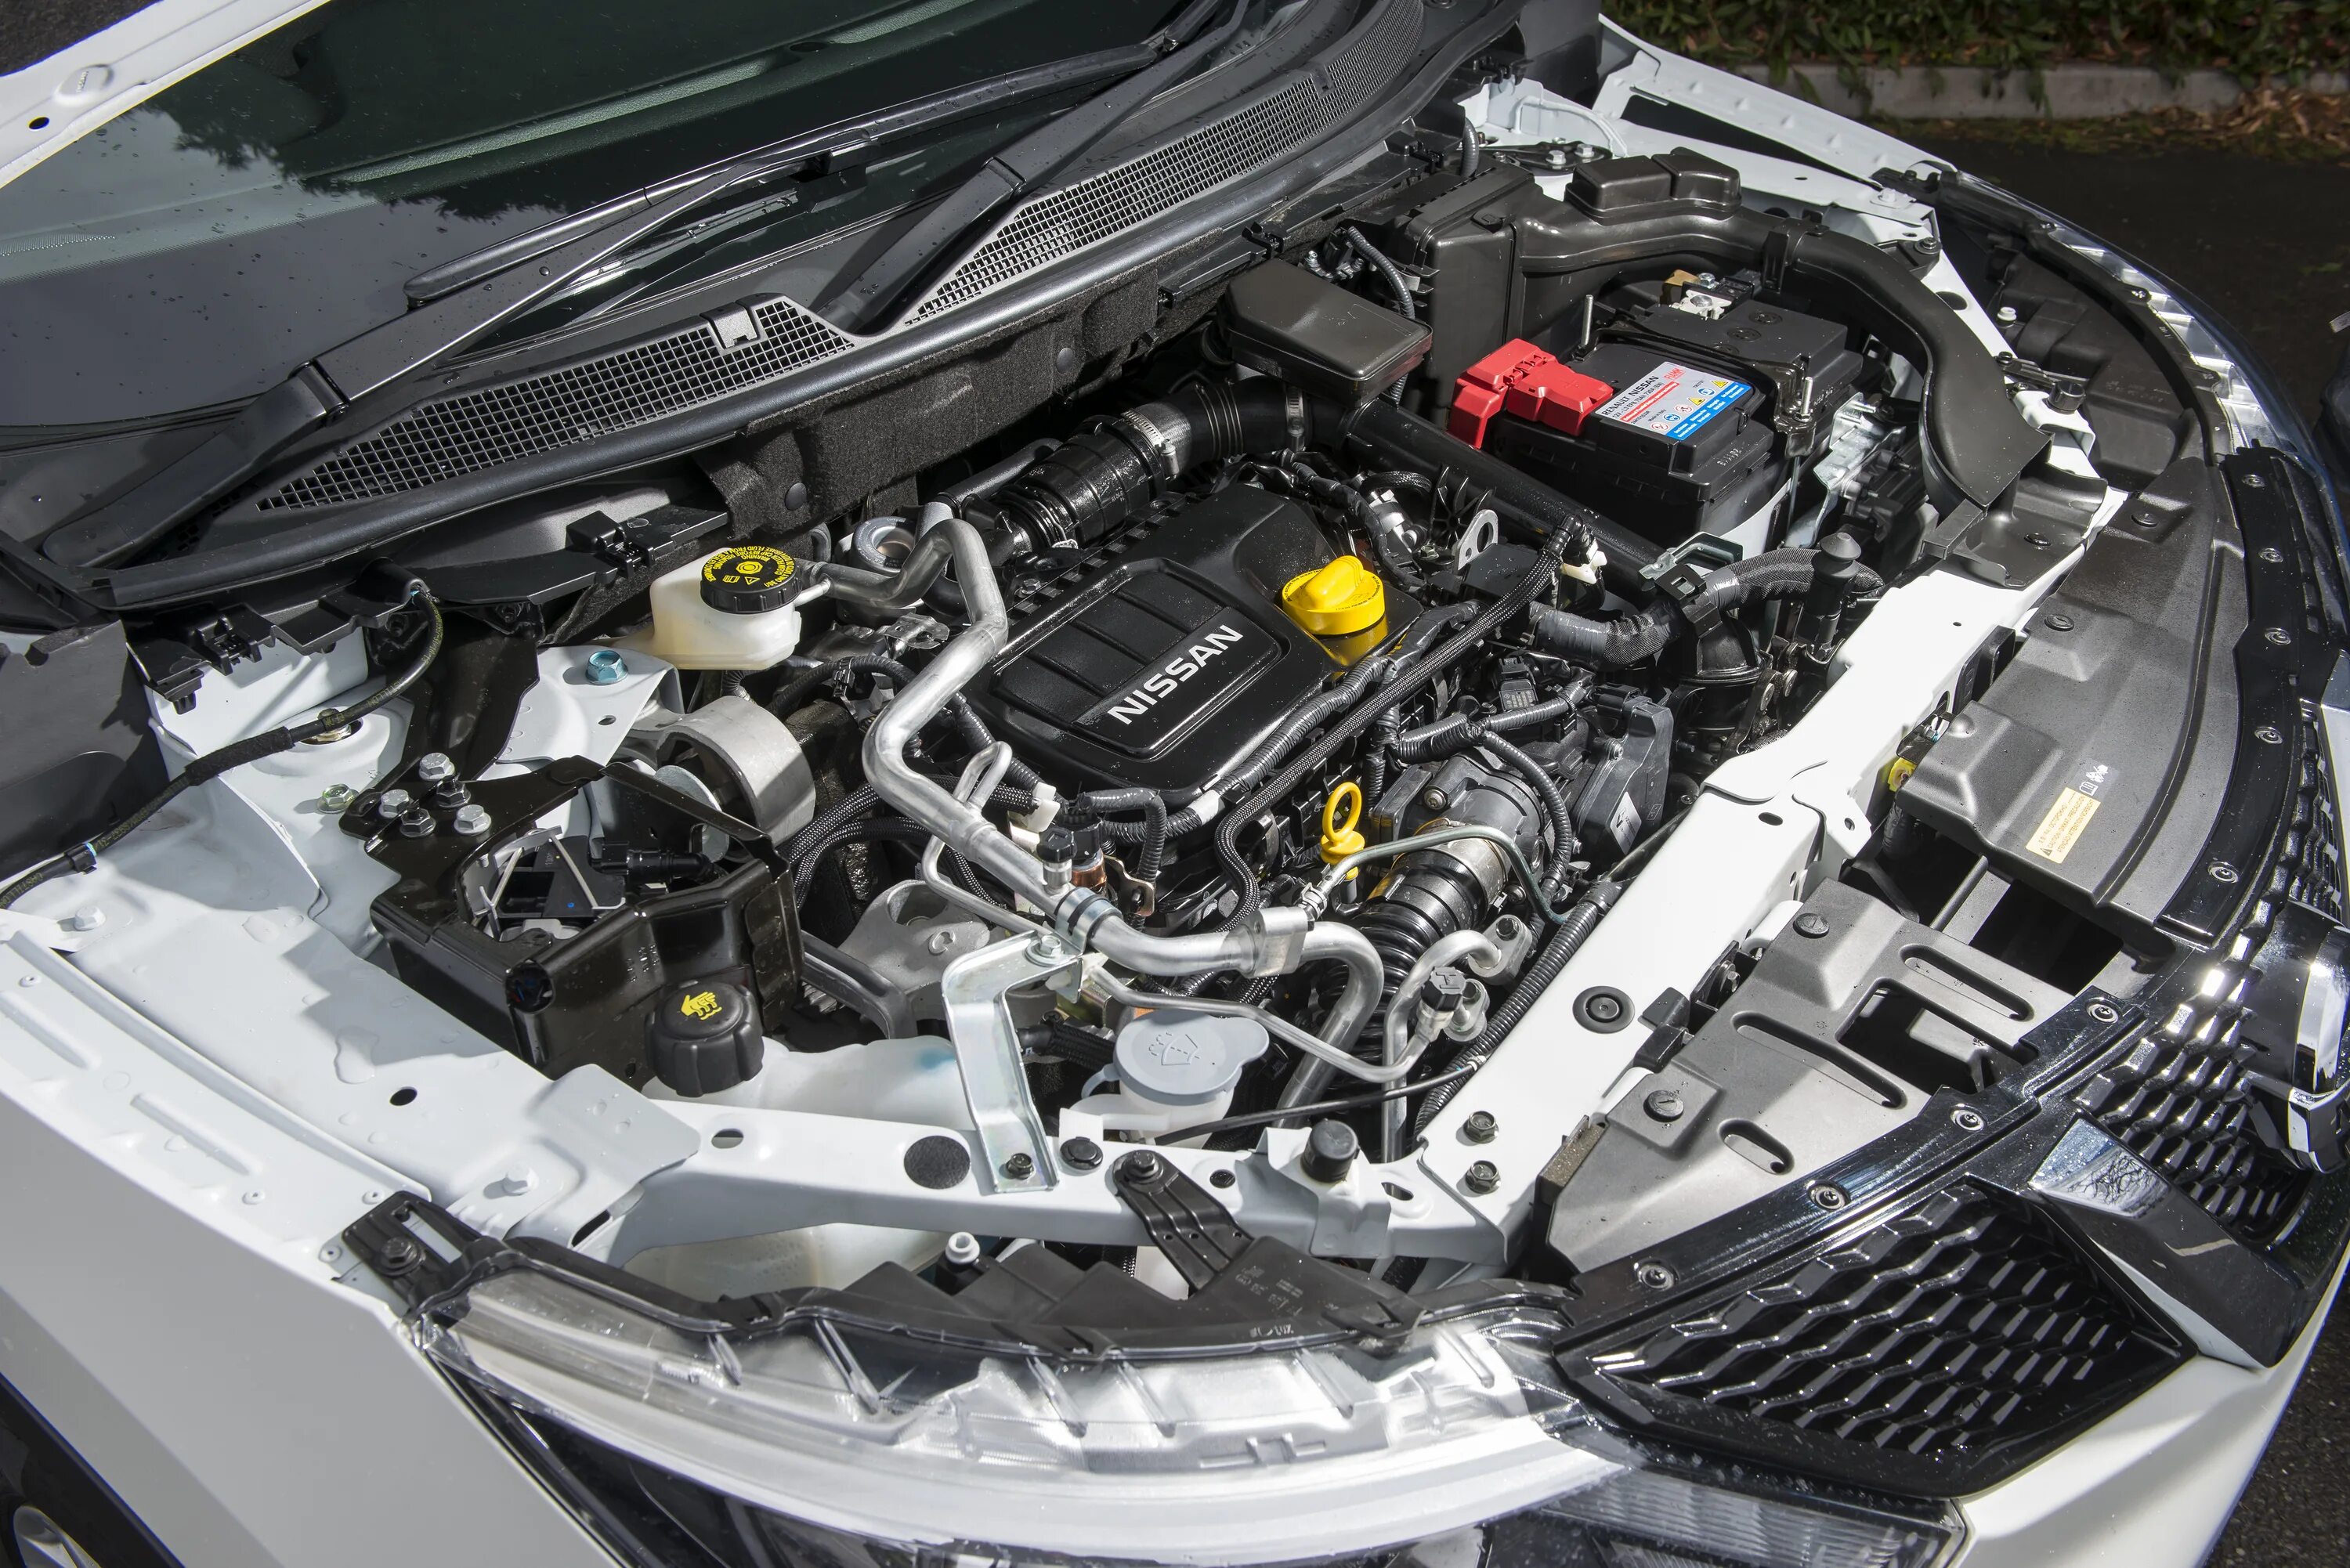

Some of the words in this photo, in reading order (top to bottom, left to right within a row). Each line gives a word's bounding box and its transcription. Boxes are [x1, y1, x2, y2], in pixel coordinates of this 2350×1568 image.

[1601, 396, 1630, 416] RENAULT
[1629, 376, 1659, 396] NISSAN
[1107, 624, 1244, 725] NISSAN
